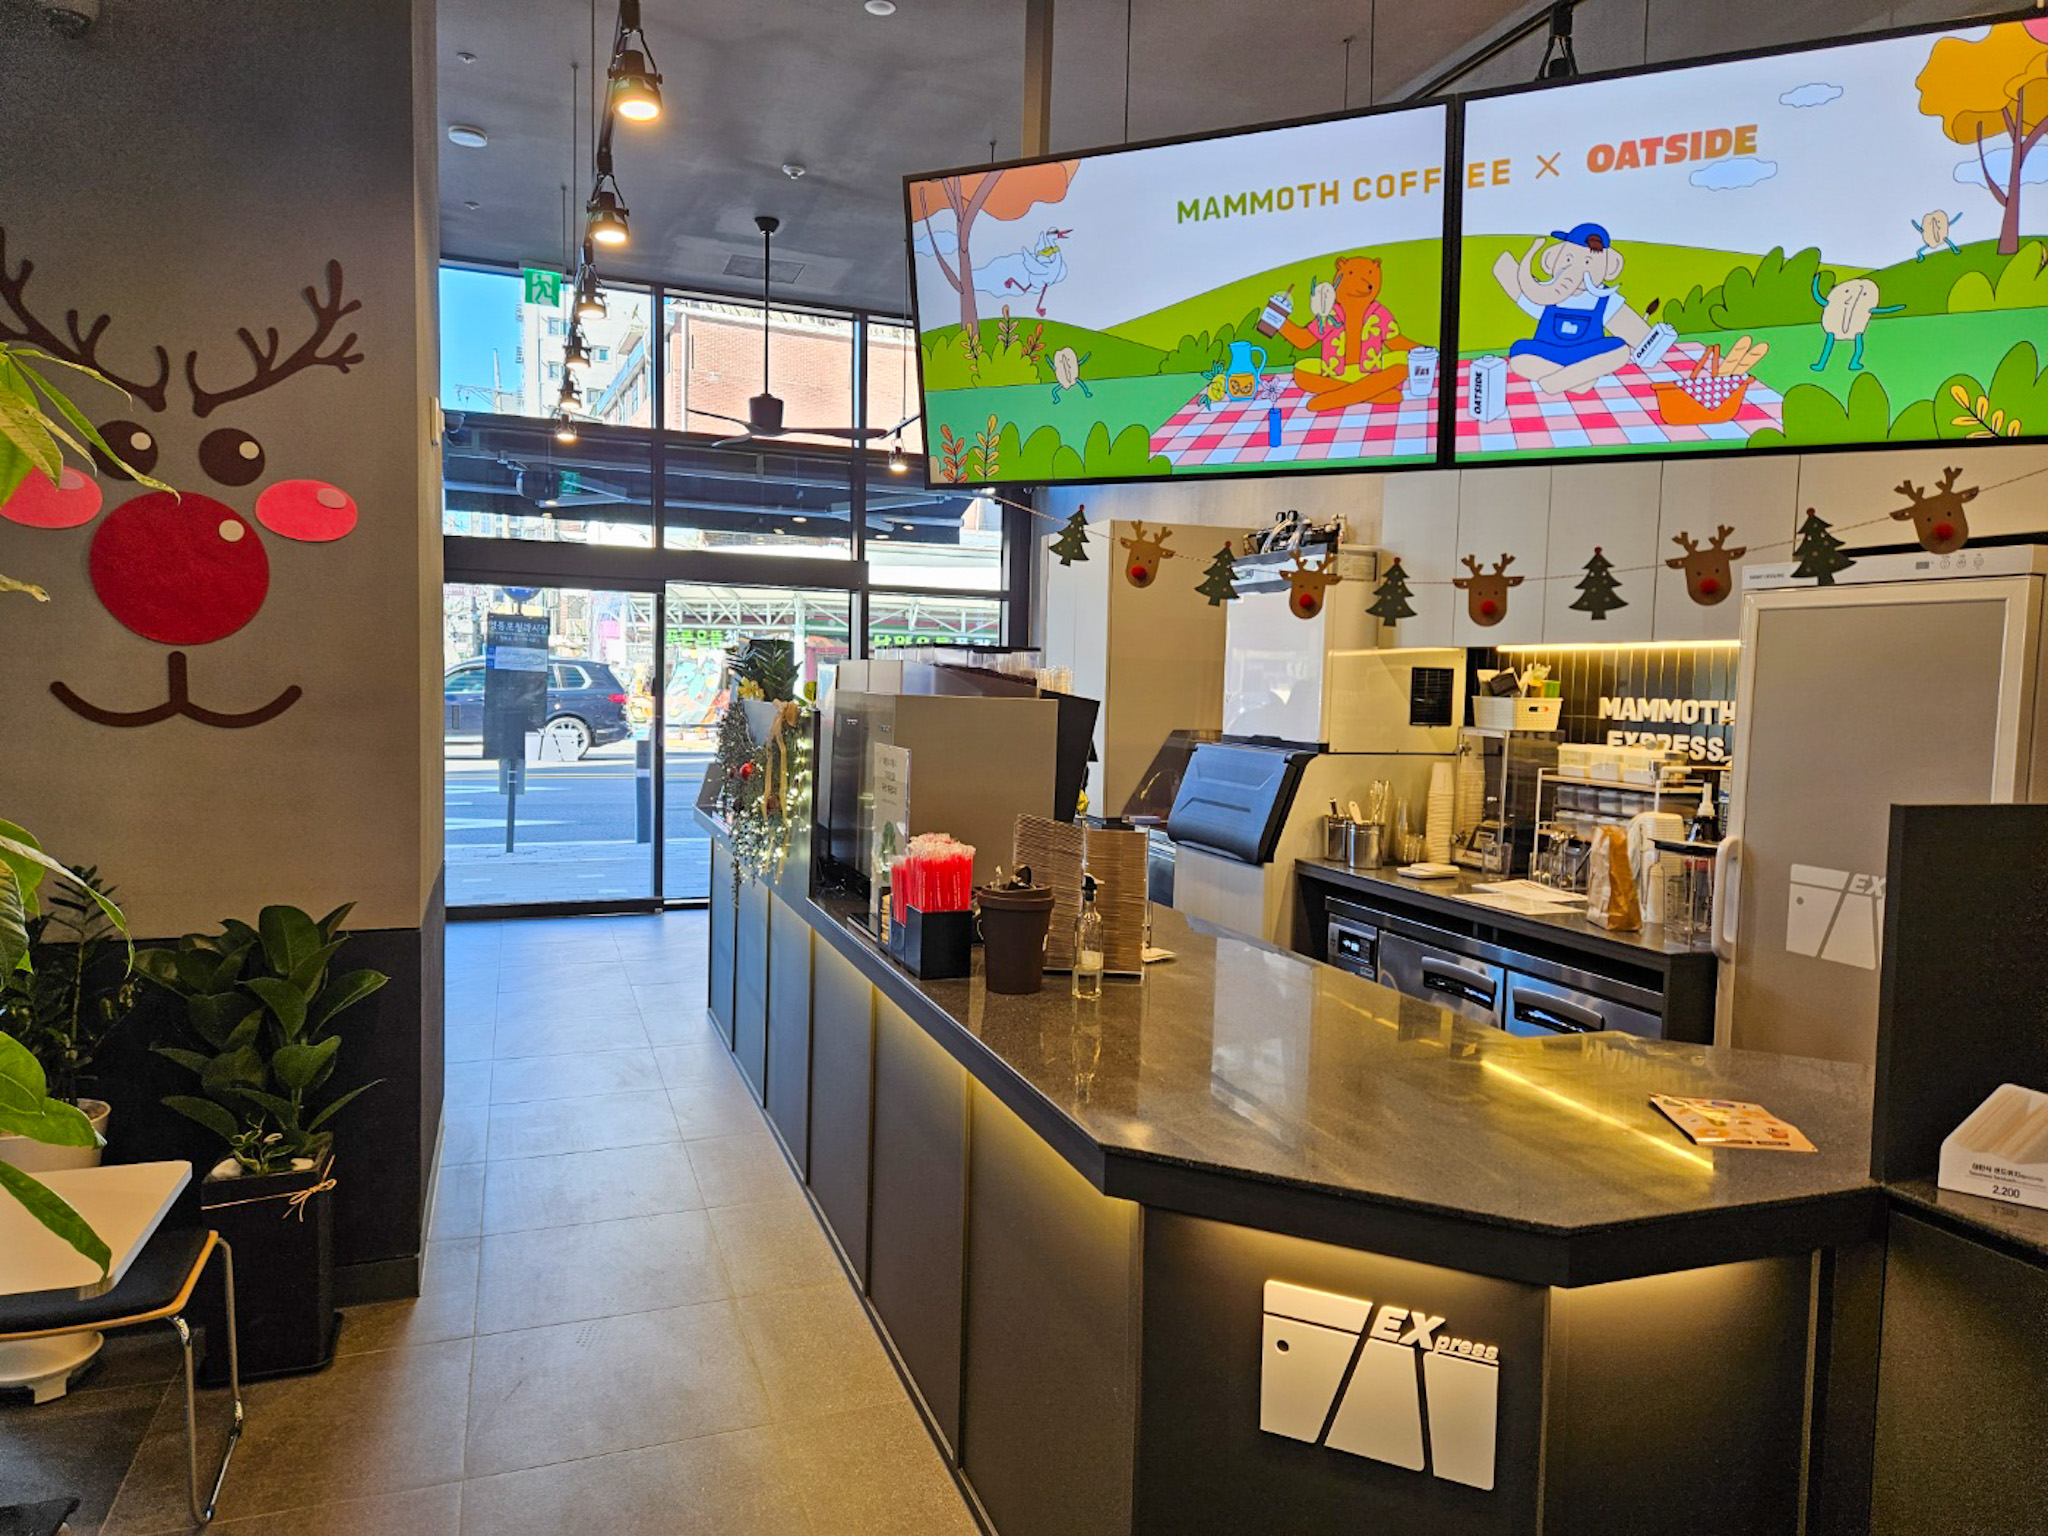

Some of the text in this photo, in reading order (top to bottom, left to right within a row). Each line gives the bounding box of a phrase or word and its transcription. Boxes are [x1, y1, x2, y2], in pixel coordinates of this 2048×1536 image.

[1177, 179, 1339, 224] MAMMOTH
[1353, 158, 1511, 203] COFFEE
[1586, 123, 1758, 174] OATSIDE
[1636, 330, 1660, 359] OATSIDE
[1473, 371, 1483, 415] OATSIDE
[1598, 696, 1736, 727] MAMMOTH
